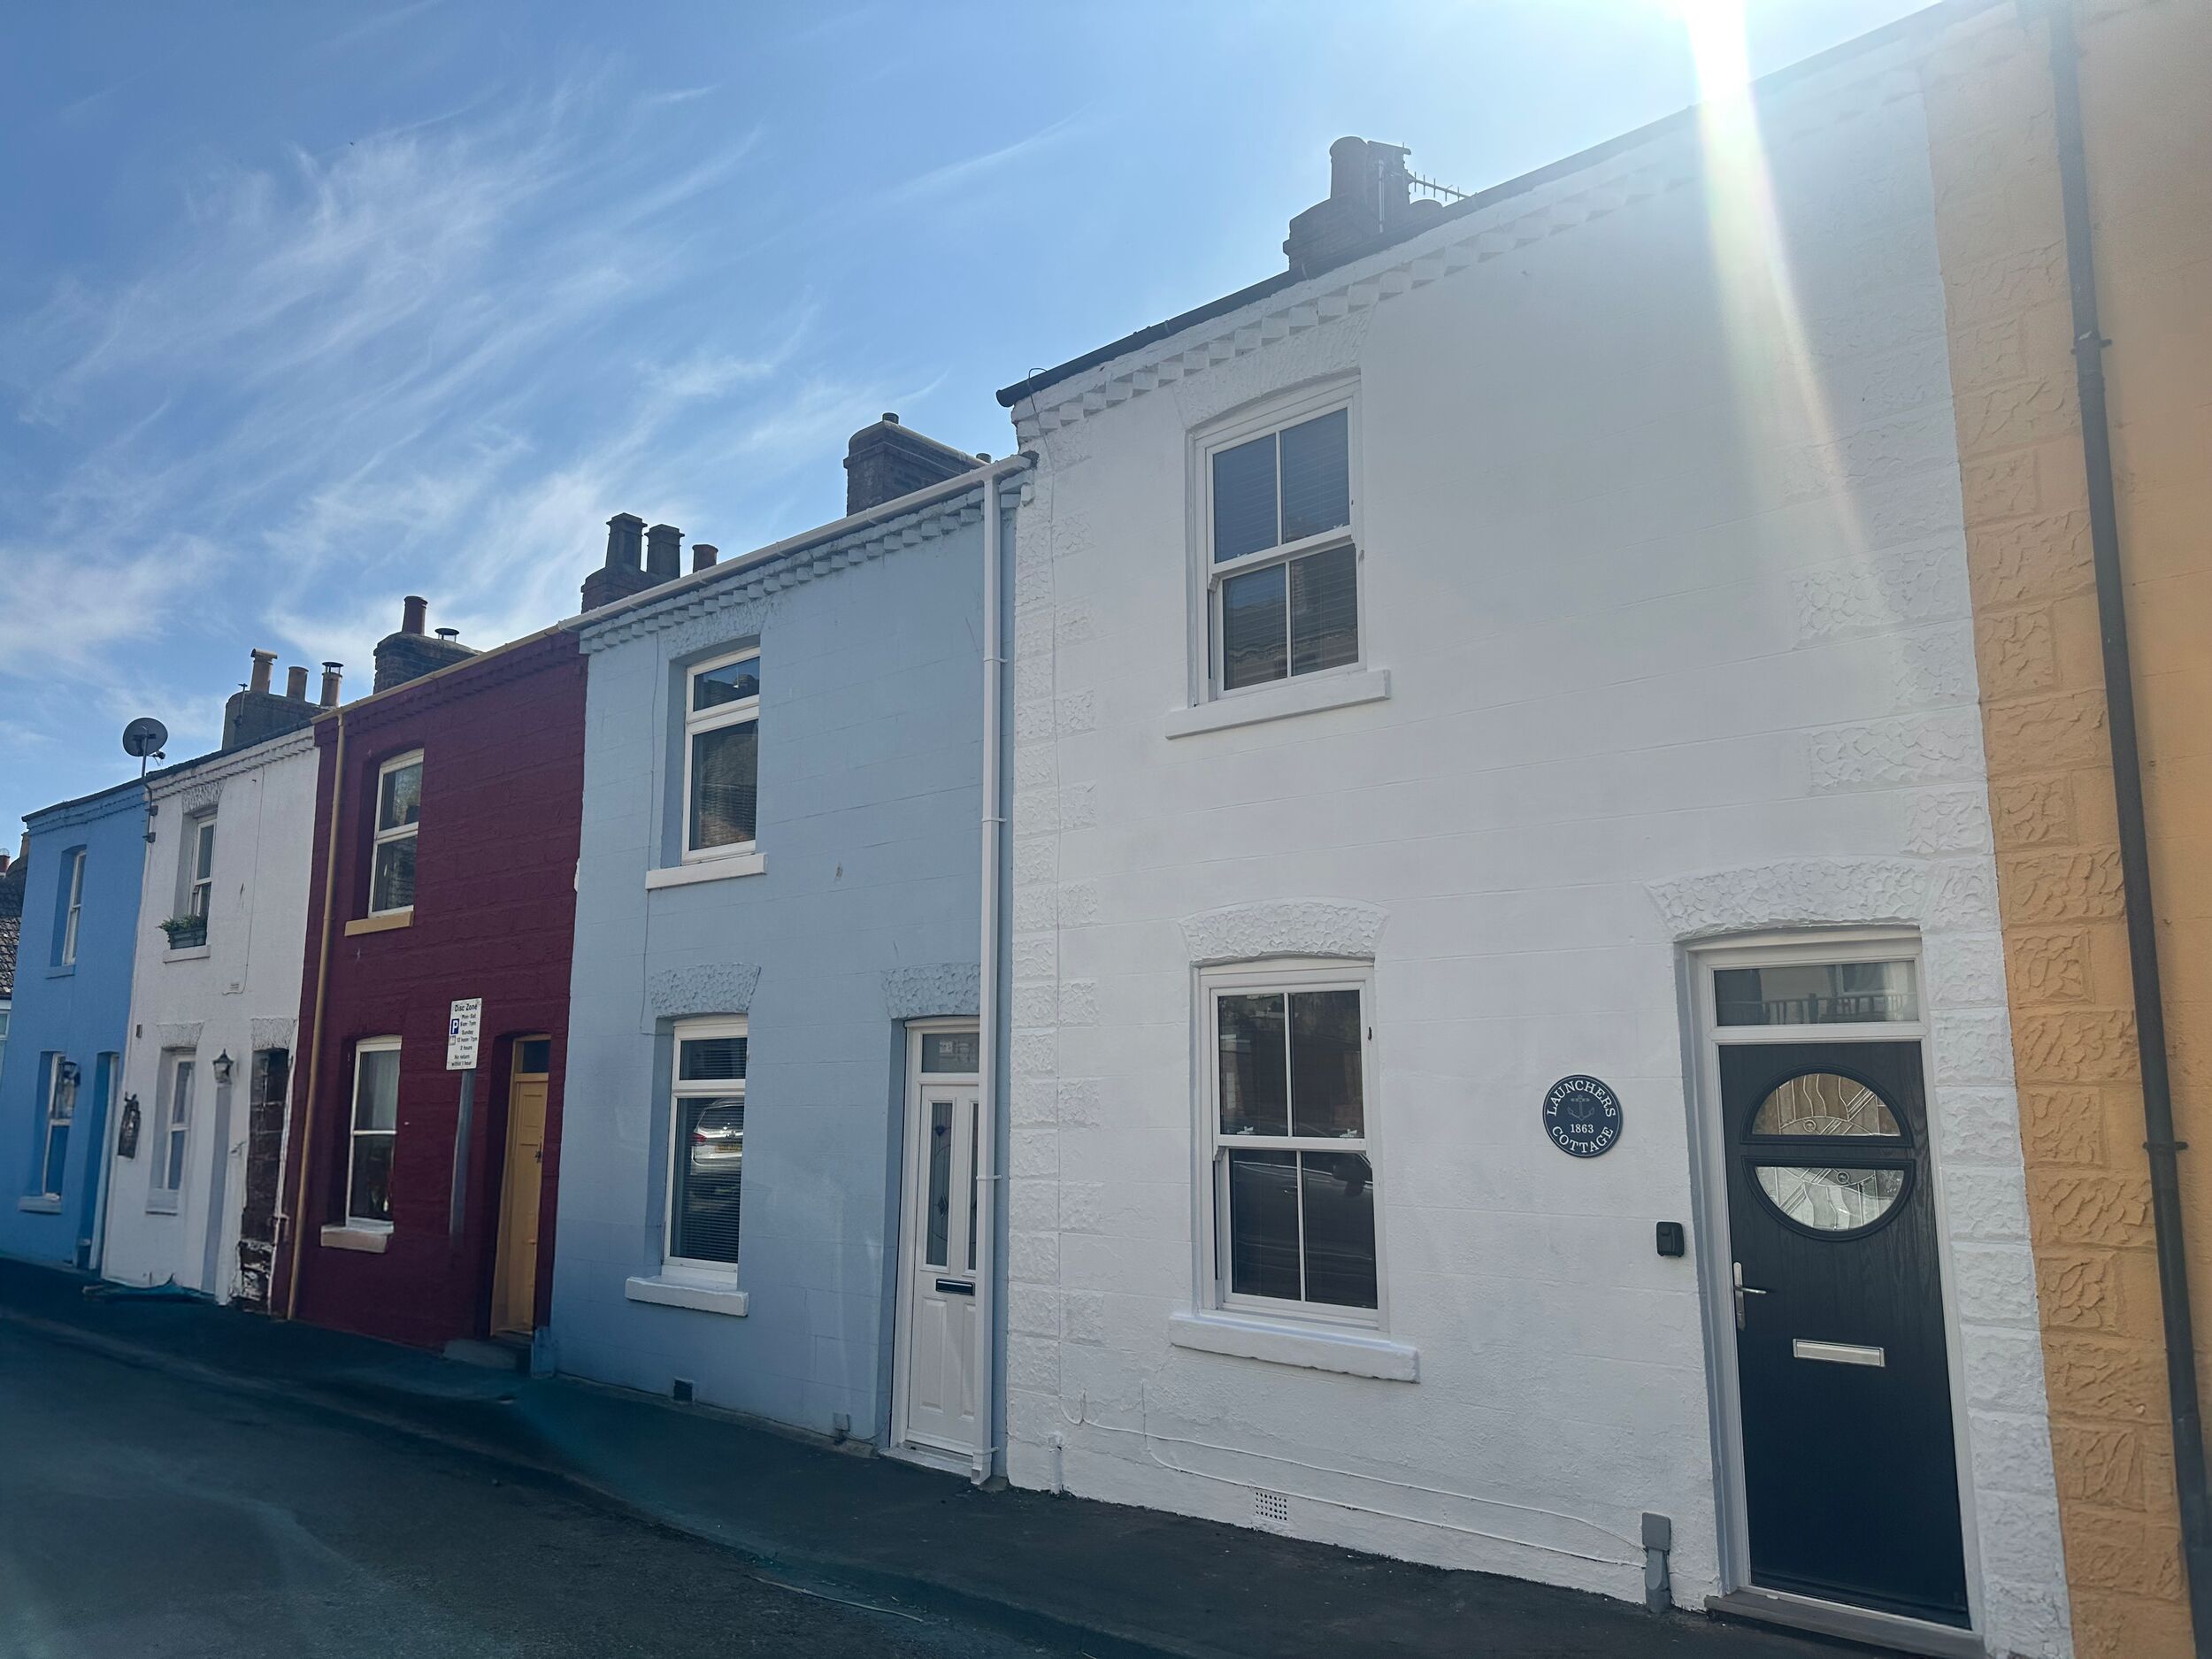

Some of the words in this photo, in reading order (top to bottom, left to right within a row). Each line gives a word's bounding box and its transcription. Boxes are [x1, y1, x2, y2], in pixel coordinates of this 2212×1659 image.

[452, 1020, 458, 1033] P
[1547, 1080, 1616, 1118] LAUNCHERS
[1571, 1124, 1594, 1133] 1863
[1552, 1126, 1614, 1153] COTTAGE
